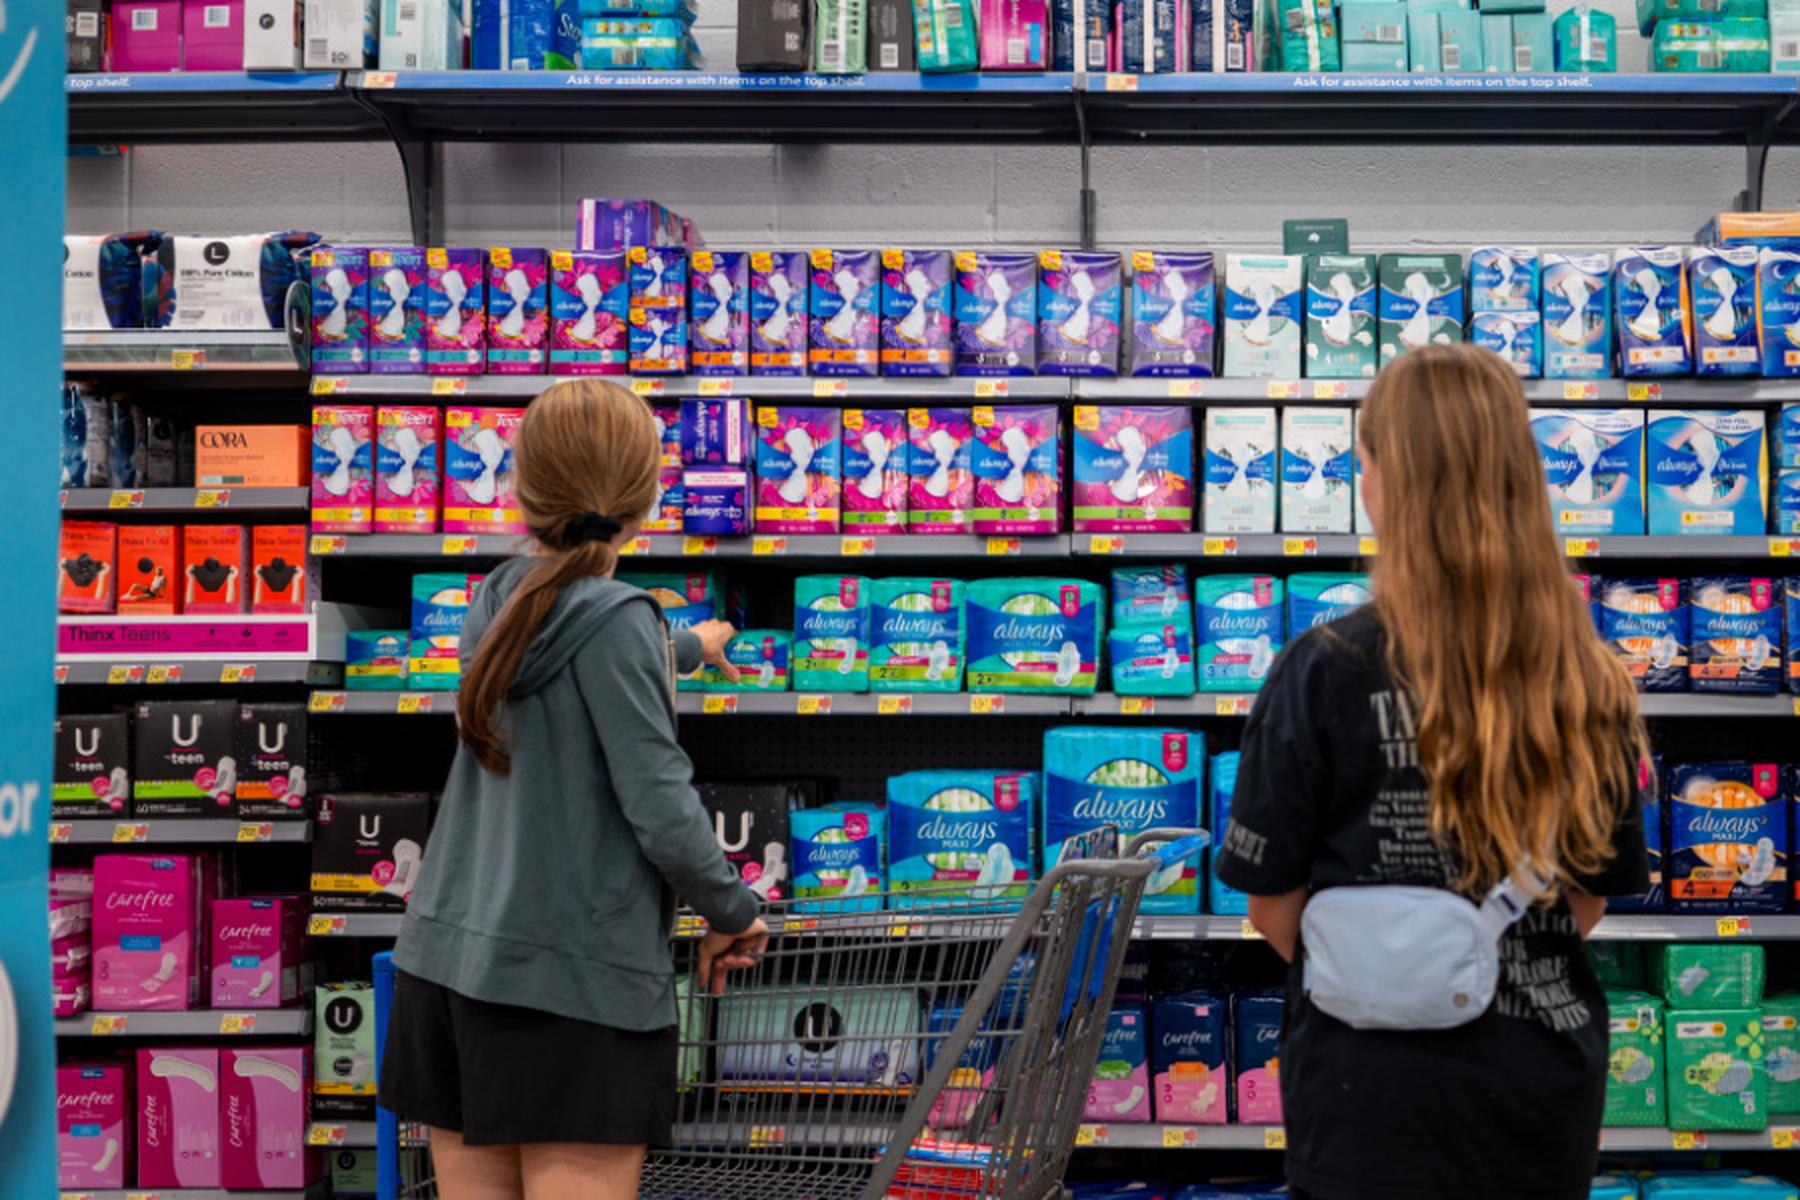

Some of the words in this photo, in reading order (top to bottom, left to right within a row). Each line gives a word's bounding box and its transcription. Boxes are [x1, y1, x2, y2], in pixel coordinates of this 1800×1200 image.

[70, 78, 94, 89] top
[96, 77, 130, 87] shelf.
[566, 75, 591, 85] Ask
[594, 75, 613, 85] for
[615, 75, 684, 85] assistance
[686, 75, 716, 85] with
[719, 75, 756, 85] items
[758, 77, 777, 85] on
[779, 75, 801, 85] the
[804, 76, 827, 88] top
[1293, 77, 1318, 87] Ask
[1321, 77, 1340, 87] for
[1343, 77, 1410, 87] assistance
[1413, 77, 1443, 87] with
[1446, 77, 1482, 87] items
[1485, 79, 1504, 87] on
[1506, 77, 1528, 87] the
[1530, 78, 1554, 90] top
[1556, 77, 1593, 87] shelf.
[200, 432, 248, 448] CORA
[423, 608, 464, 627] alwa
[804, 613, 858, 634] always
[883, 613, 947, 638] always
[1209, 612, 1271, 636] always
[1615, 614, 1668, 634] always
[1706, 613, 1760, 634] always
[68, 626, 116, 642] Thinx
[120, 627, 172, 642] Teens
[993, 617, 1066, 647] always
[172, 713, 202, 747] U
[258, 722, 287, 754] U
[76, 727, 101, 757] U
[76, 760, 104, 772] teen
[172, 752, 205, 764] teen
[258, 759, 290, 771] teen
[1072, 790, 1170, 830] always
[360, 814, 381, 839] U
[716, 811, 754, 853] U
[916, 815, 1000, 848] always
[1687, 810, 1760, 842] always
[942, 838, 971, 849] MAXI
[808, 845, 861, 866] always
[1682, 880, 1695, 897] 4
[106, 889, 175, 912] Carefree
[220, 922, 273, 941] Carefree
[334, 1006, 354, 1028] U
[1163, 1030, 1213, 1047] Carefree
[58, 1091, 115, 1110] Carefree
